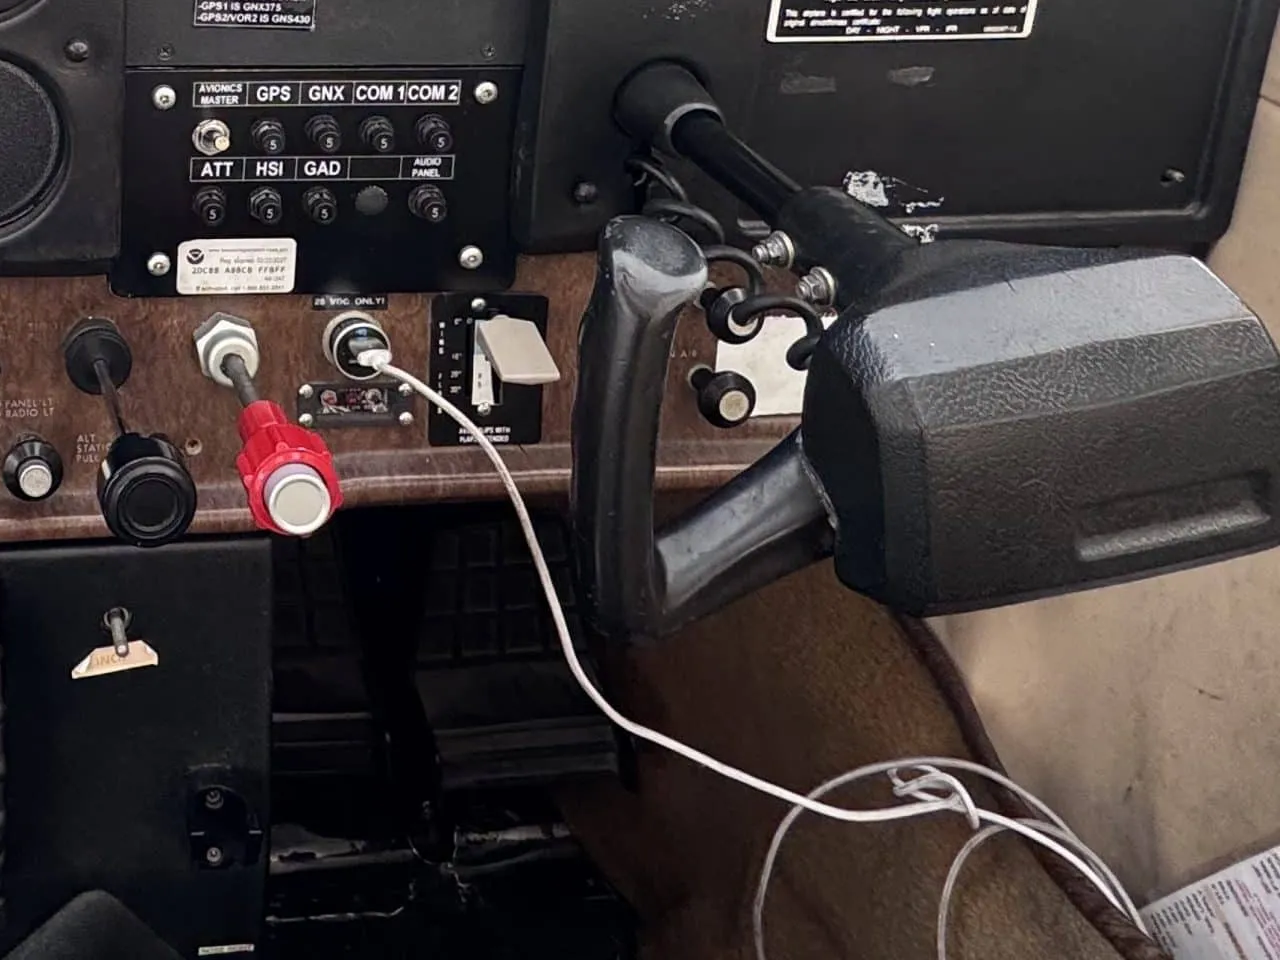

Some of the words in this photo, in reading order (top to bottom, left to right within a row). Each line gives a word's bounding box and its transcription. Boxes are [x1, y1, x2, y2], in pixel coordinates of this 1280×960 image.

[198, 1, 227, 11] -GPS1
[231, 3, 240, 11] IS
[243, 3, 281, 12] GNX375
[259, 14, 269, 23] IS
[272, 14, 310, 24] GNS430
[199, 83, 242, 93] AVIONICS
[256, 85, 292, 101] GPS
[308, 85, 345, 101] GNX
[356, 85, 394, 100] COM
[398, 85, 405, 100] 1
[408, 85, 445, 100] COM
[448, 85, 459, 100] 2
[200, 95, 239, 105] MASTER
[270, 139, 277, 150] 5
[326, 138, 334, 148] 5
[381, 138, 388, 149] 5
[437, 137, 445, 148] 5
[414, 158, 442, 167] AUDIO
[201, 161, 234, 177] ATT
[256, 161, 283, 177] HSI
[304, 161, 341, 176] GAD
[412, 169, 440, 177] PANEL
[210, 209, 217, 220] 5
[266, 208, 274, 219] 5
[321, 208, 328, 219] 5
[432, 207, 439, 218] 5
[355, 297, 385, 305] ONLY!
[5, 408, 39, 418] RADIO
[43, 408, 54, 417] LT
[77, 434, 95, 443] ALT
